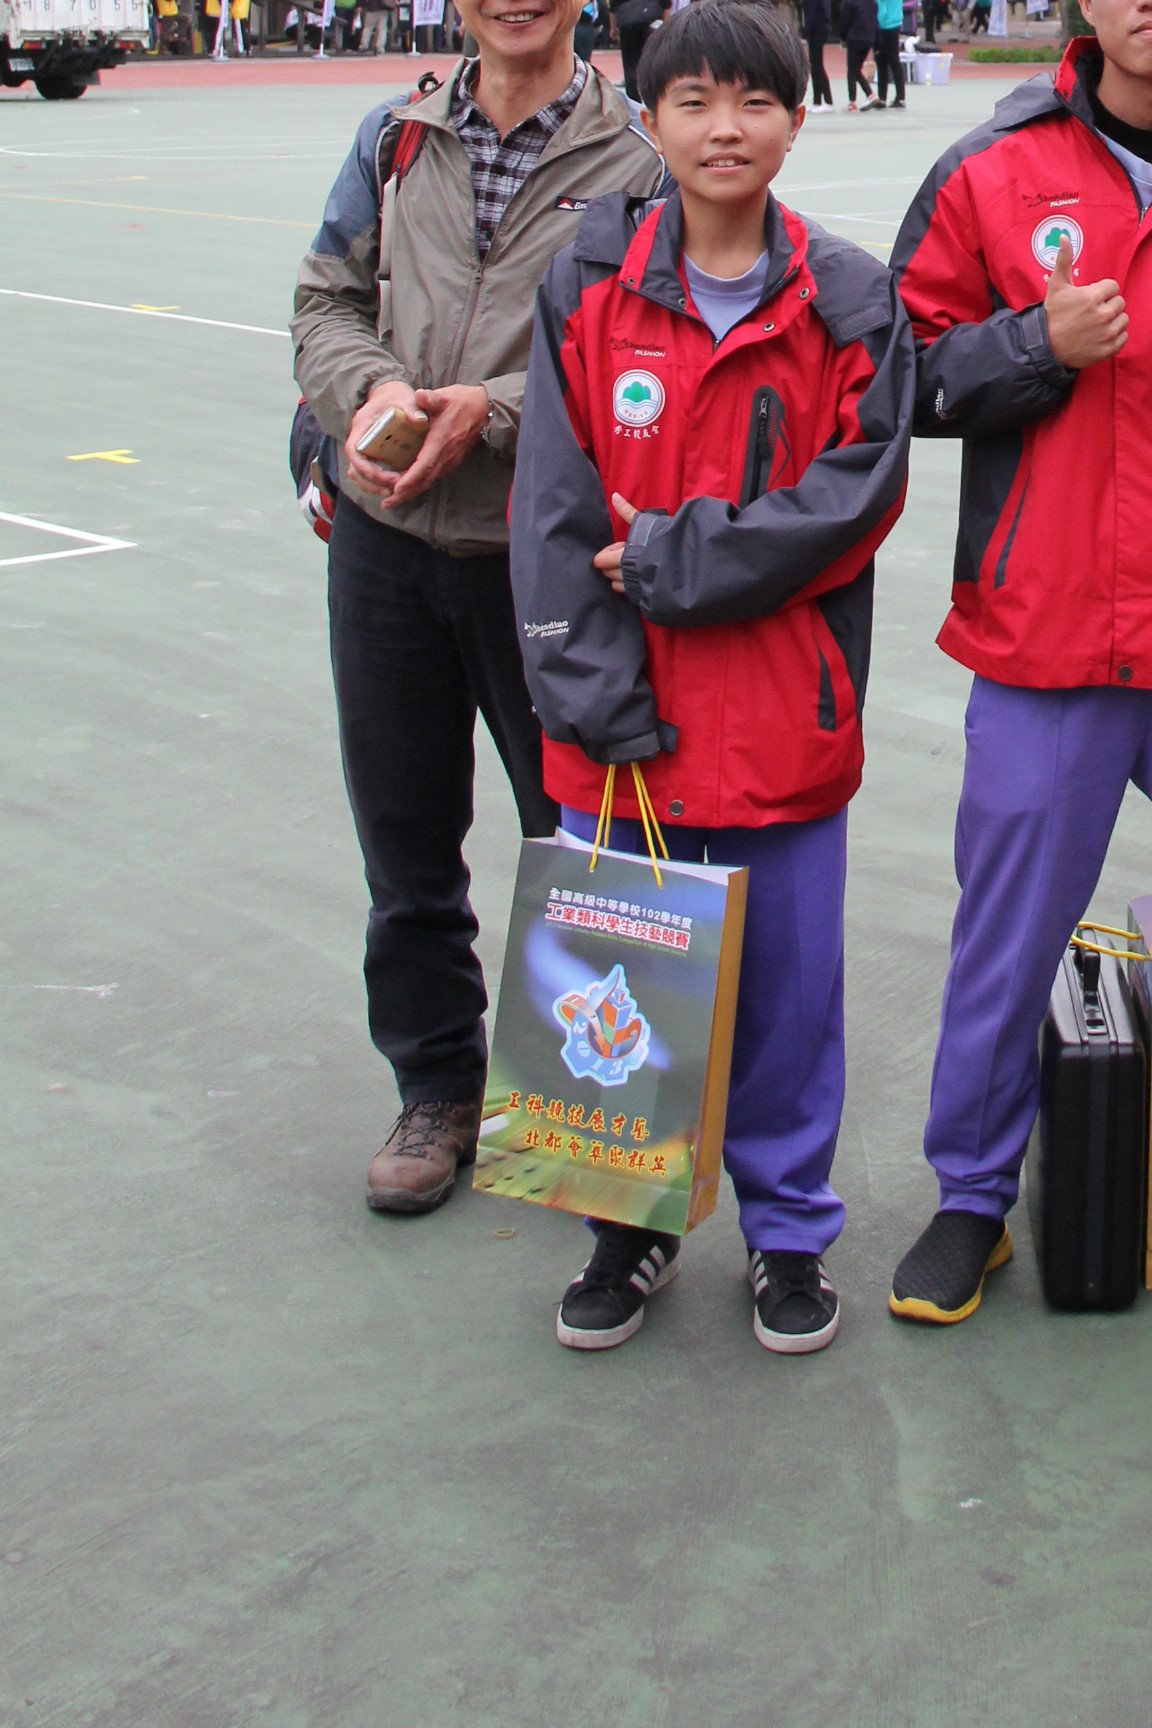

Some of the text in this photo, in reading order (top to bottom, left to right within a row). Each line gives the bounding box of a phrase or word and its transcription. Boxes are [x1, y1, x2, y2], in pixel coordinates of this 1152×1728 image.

[1050, 198, 1080, 208] FASHION
[634, 349, 667, 358] FASHION
[544, 901, 691, 951] 工業類科學生技藝競賽
[548, 886, 693, 930] 全國高級中等學校102學年度
[507, 1089, 650, 1143] 工科競技展才藝
[523, 1126, 669, 1178] 北都薈萃聚群英
